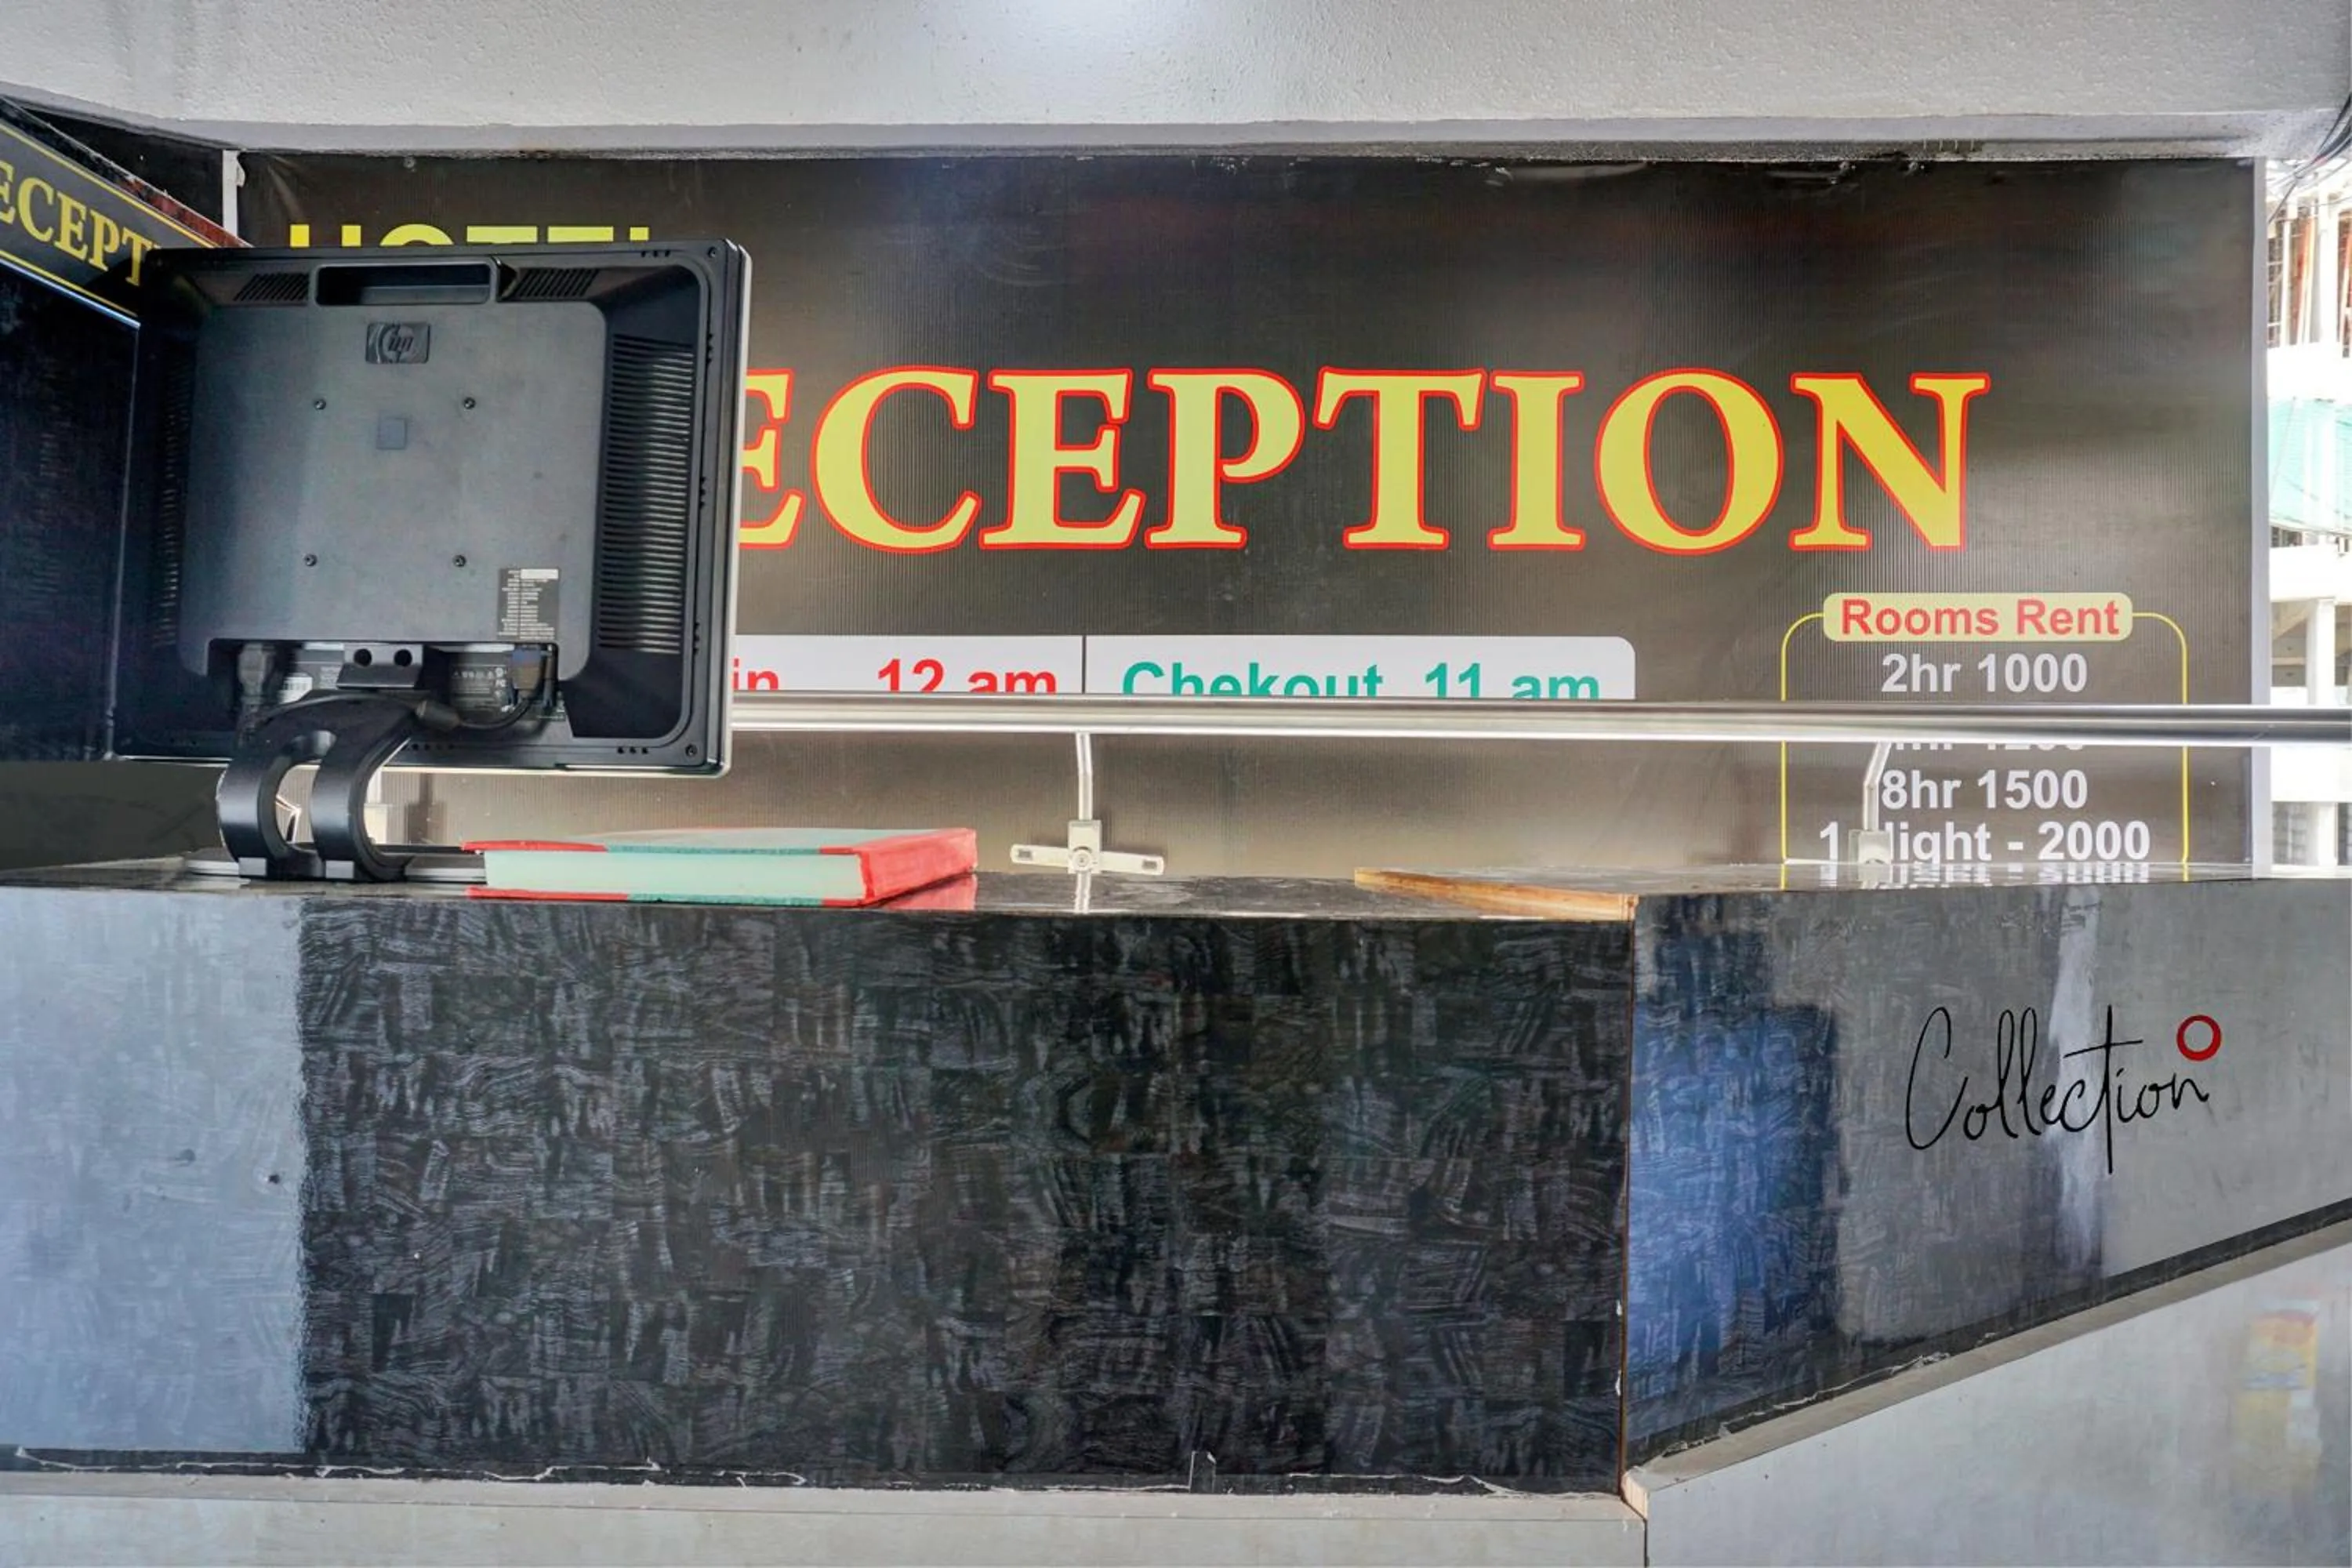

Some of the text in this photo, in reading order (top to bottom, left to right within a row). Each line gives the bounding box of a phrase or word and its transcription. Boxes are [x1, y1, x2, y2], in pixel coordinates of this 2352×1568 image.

[0, 161, 162, 286] CEPT
[1842, 599, 2121, 635] Rooms Rent
[1882, 653, 2087, 692] 2hr 1000
[1882, 770, 2087, 809] 8hr 1500
[1819, 822, 1838, 861] 1
[2038, 821, 2150, 861] 2000
[1906, 1004, 2209, 1174] Collection
